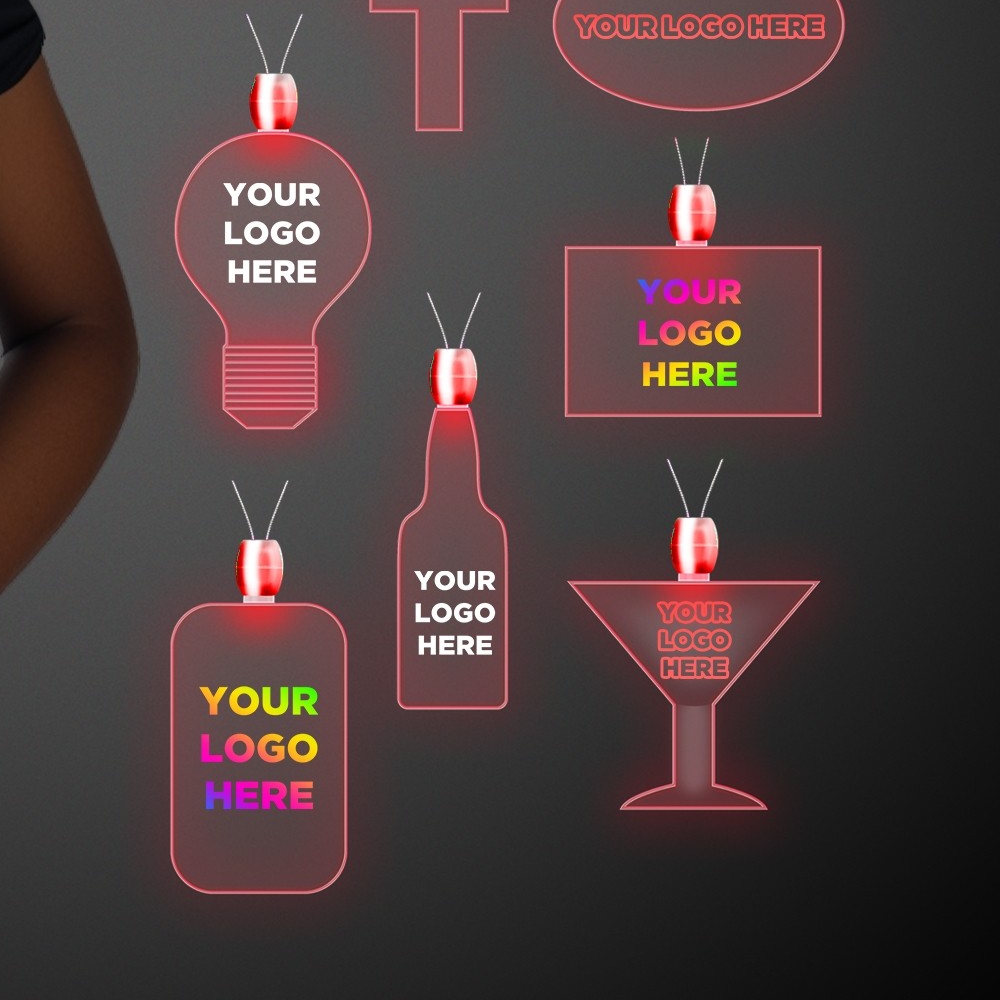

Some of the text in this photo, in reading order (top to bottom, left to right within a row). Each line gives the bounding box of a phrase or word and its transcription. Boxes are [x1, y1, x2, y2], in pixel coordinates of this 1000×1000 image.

[573, 14, 825, 39] YOUR LOGO HERE
[223, 182, 321, 207] YOUR
[224, 220, 321, 246] LOGO
[228, 259, 317, 284] HERE
[637, 278, 742, 306] YOUR
[638, 319, 742, 347] LOGO
[642, 361, 738, 387] HERE
[413, 570, 496, 591] YOUR
[415, 602, 496, 624] LOGO
[657, 601, 732, 624] YOUR
[418, 635, 493, 656] HERE
[657, 628, 732, 652] LOGO
[660, 656, 729, 679] HERE
[199, 685, 319, 716] YOUR
[200, 733, 319, 764] LOGO
[205, 780, 314, 810] HERE
